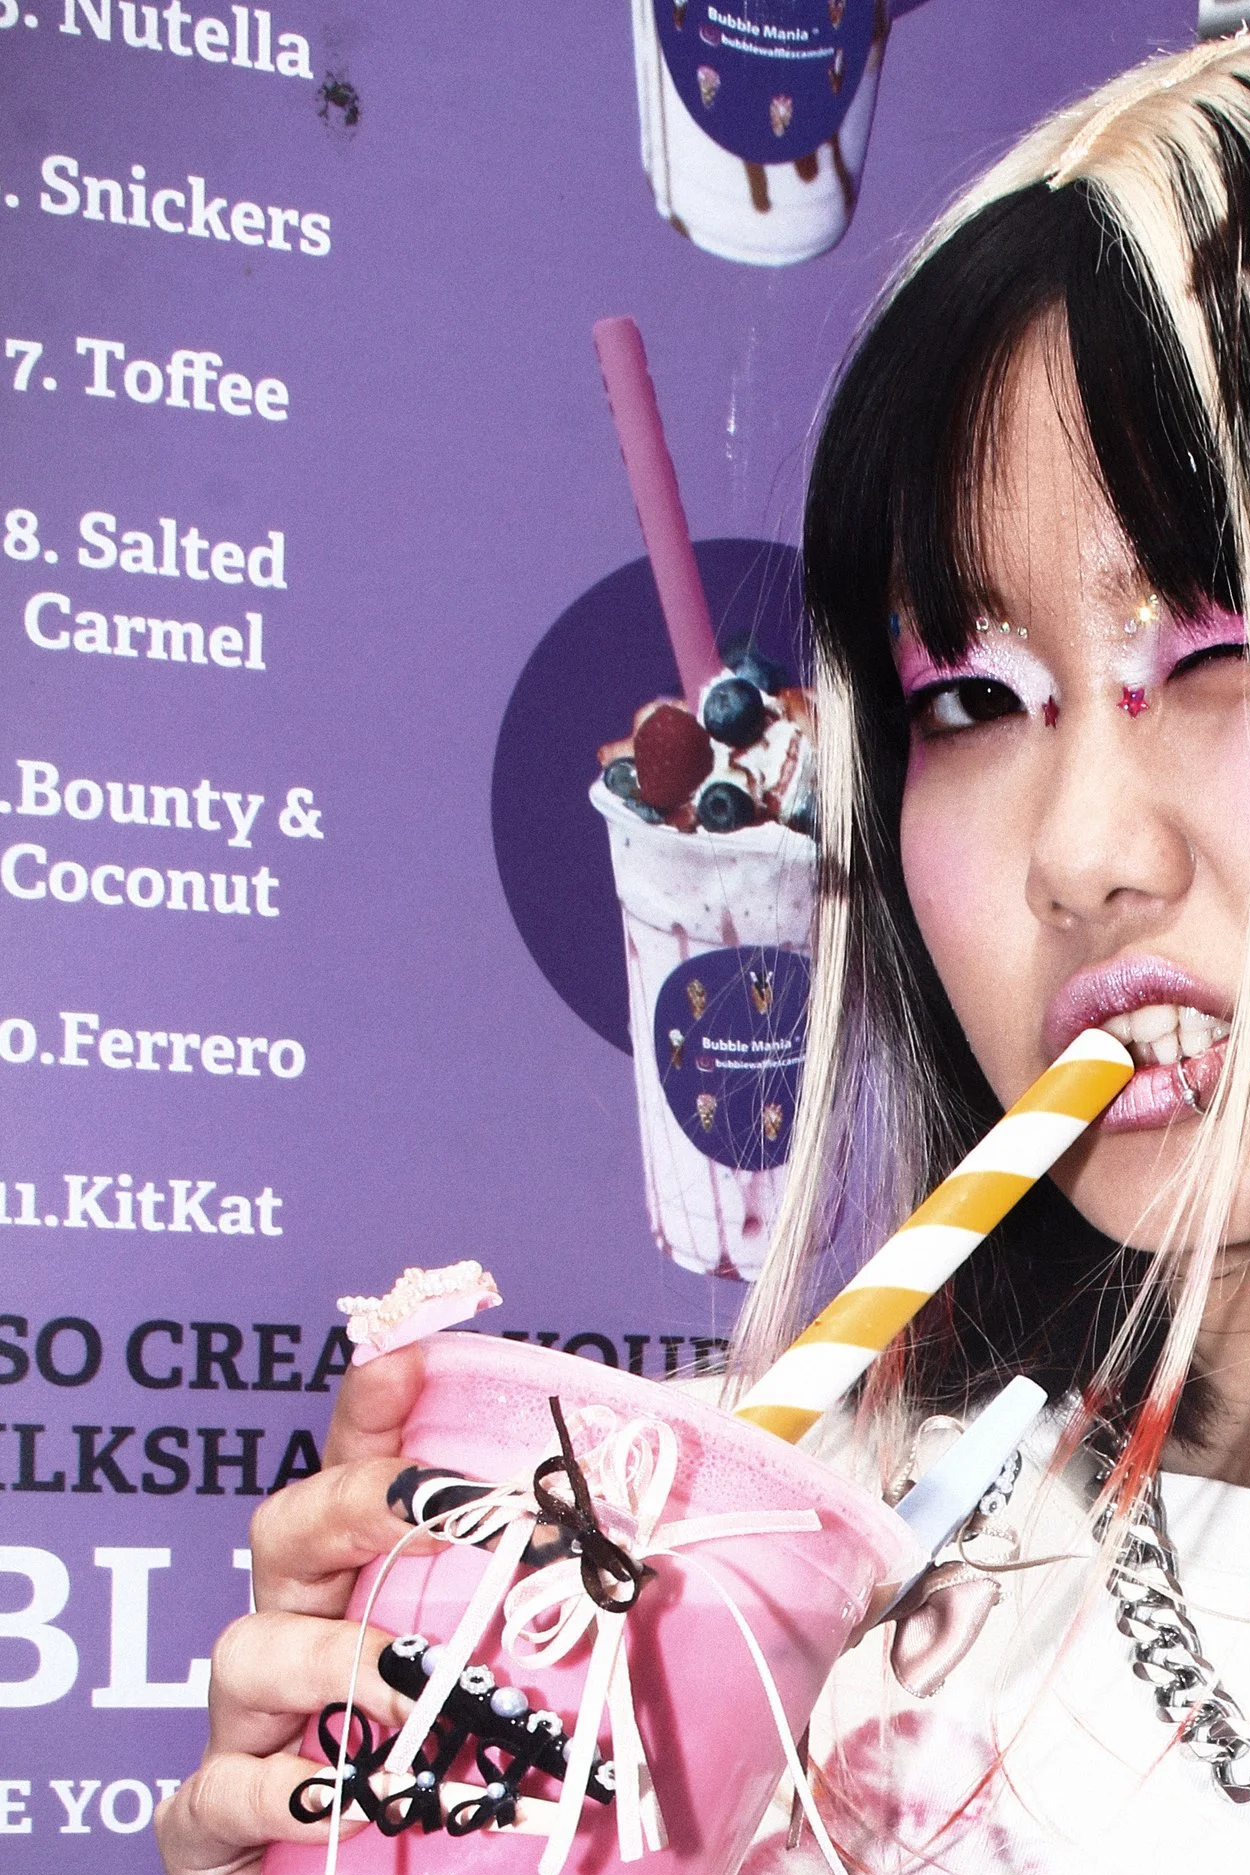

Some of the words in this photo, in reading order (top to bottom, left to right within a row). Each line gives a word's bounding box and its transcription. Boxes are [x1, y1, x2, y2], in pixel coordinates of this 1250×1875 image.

[59, 0, 314, 79] Nutella
[708, 6, 760, 36] Bubble
[763, 25, 808, 41] Mania
[40, 155, 331, 256] Snickers
[5, 339, 57, 391] 7.
[76, 337, 289, 421] Toffee
[3, 508, 58, 563] 8.
[78, 511, 287, 589] Salted
[24, 592, 266, 670] Carmel
[278, 787, 324, 839] &
[1, 843, 280, 917] Coconut
[702, 1037, 748, 1052] Bubble
[751, 1038, 792, 1052] Mania
[126, 1320, 353, 1392] CREA
[0, 1424, 321, 1497] LKSHA
[0, 1545, 257, 1708] BL
